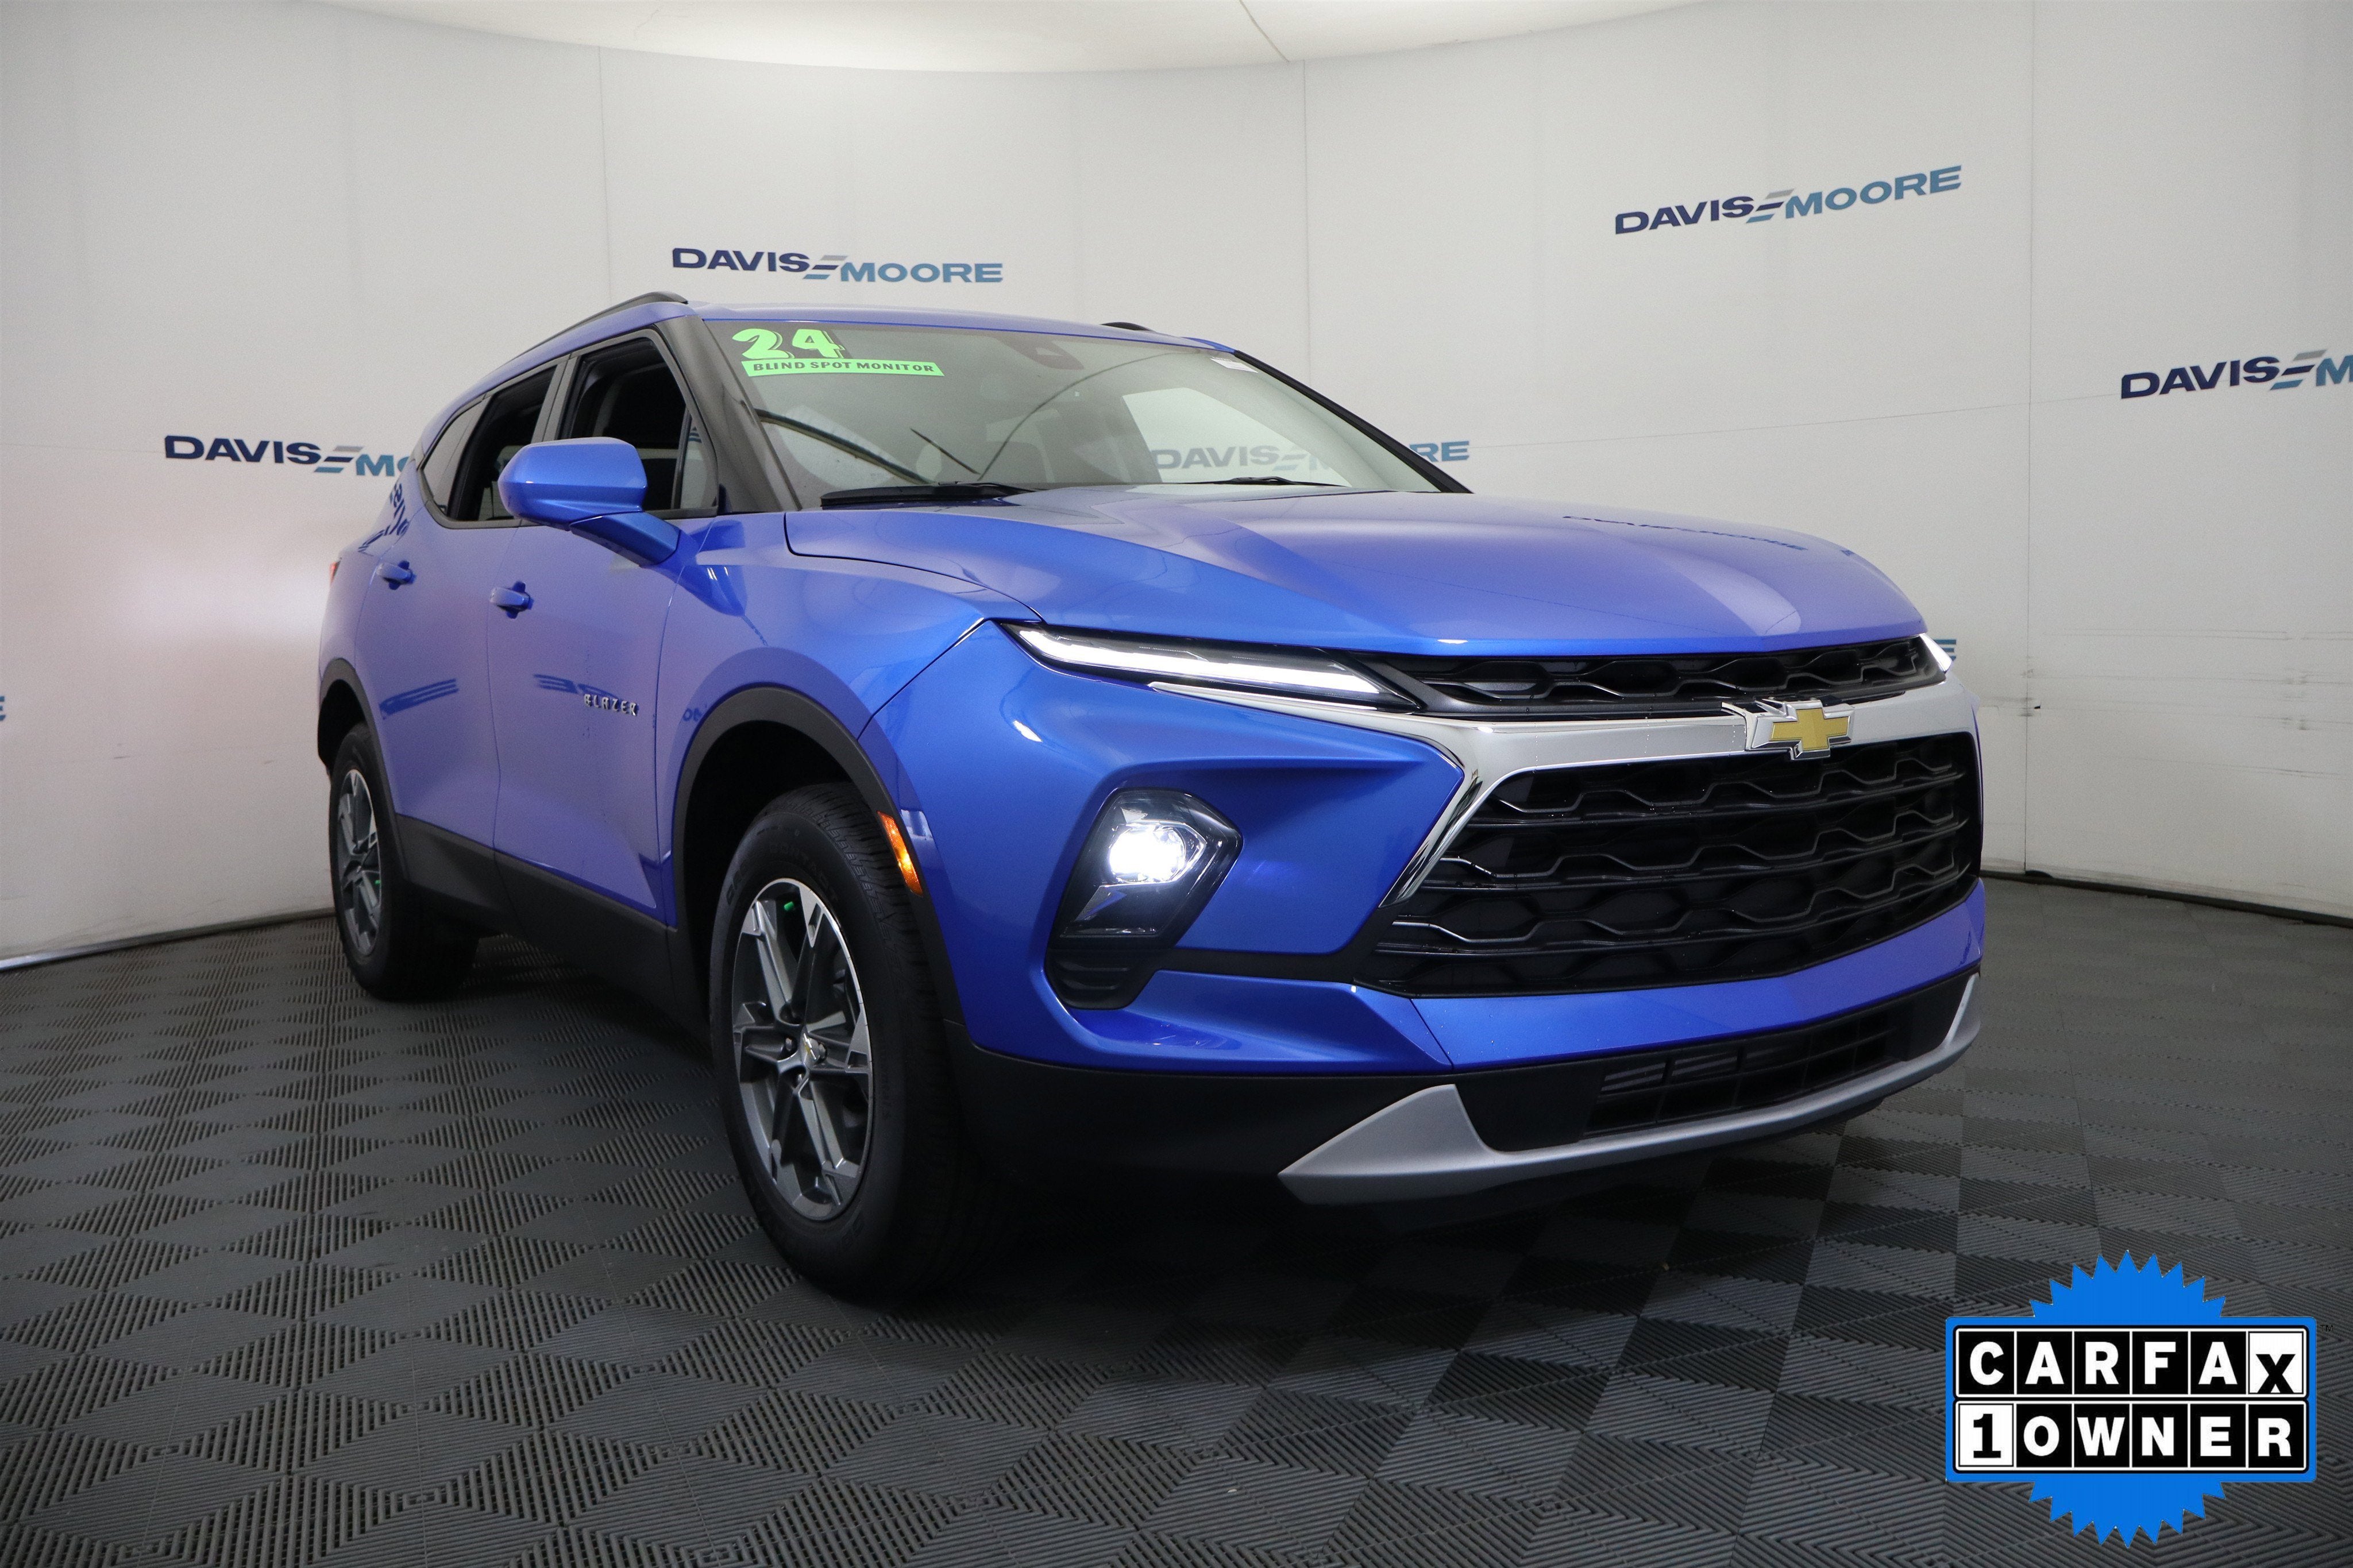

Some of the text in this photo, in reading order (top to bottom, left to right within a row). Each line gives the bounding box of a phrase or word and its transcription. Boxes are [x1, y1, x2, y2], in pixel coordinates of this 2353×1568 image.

[1615, 165, 1962, 234] DAVIS MOORE
[672, 248, 1004, 283] DAVIS MOORE
[732, 328, 846, 359] 24
[753, 361, 935, 372] BLIND SPOT MONITOR
[2121, 356, 2280, 399] DAVIS
[164, 435, 322, 465] DAVIS
[1150, 445, 1280, 469] DAVIS
[584, 693, 638, 716] BLAZER
